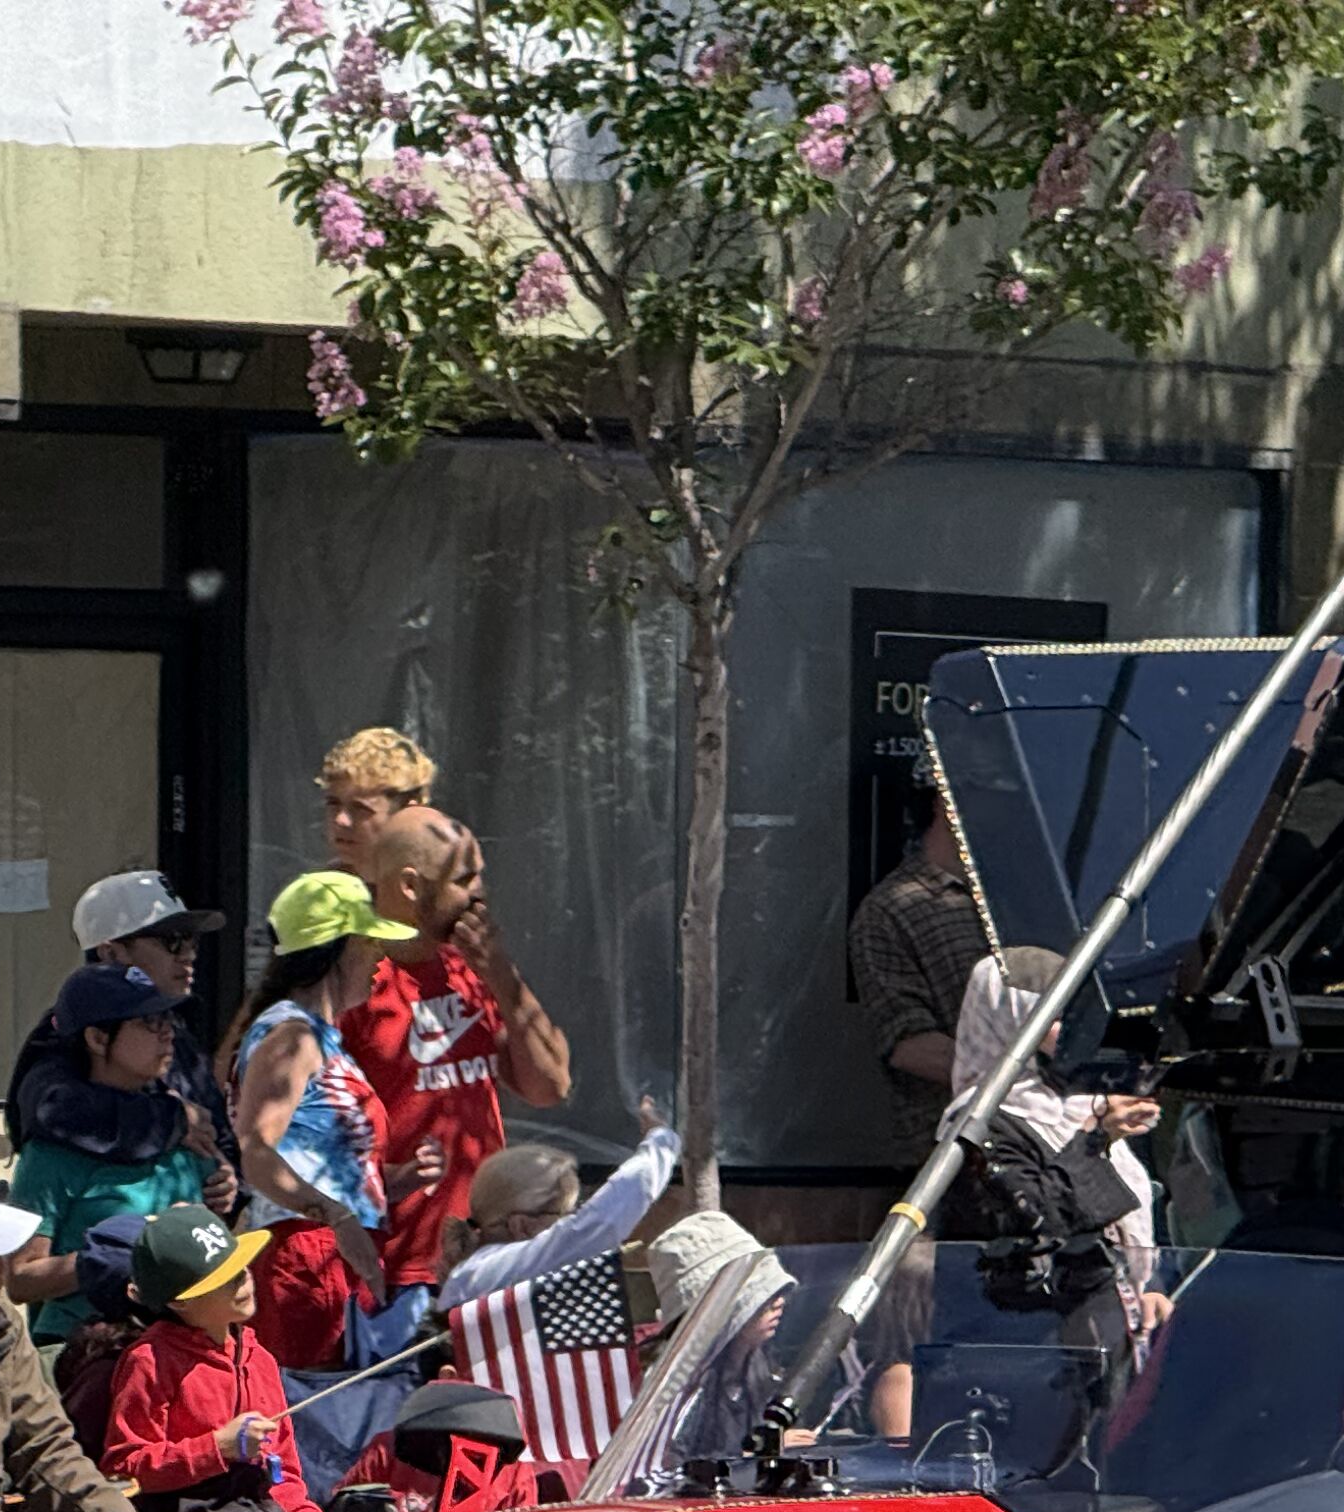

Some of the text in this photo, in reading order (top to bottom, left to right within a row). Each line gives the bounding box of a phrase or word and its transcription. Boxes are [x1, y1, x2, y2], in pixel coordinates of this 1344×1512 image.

[411, 992, 467, 1034] NIKE
[414, 1063, 459, 1092] JUST
[458, 1056, 489, 1084] DO
